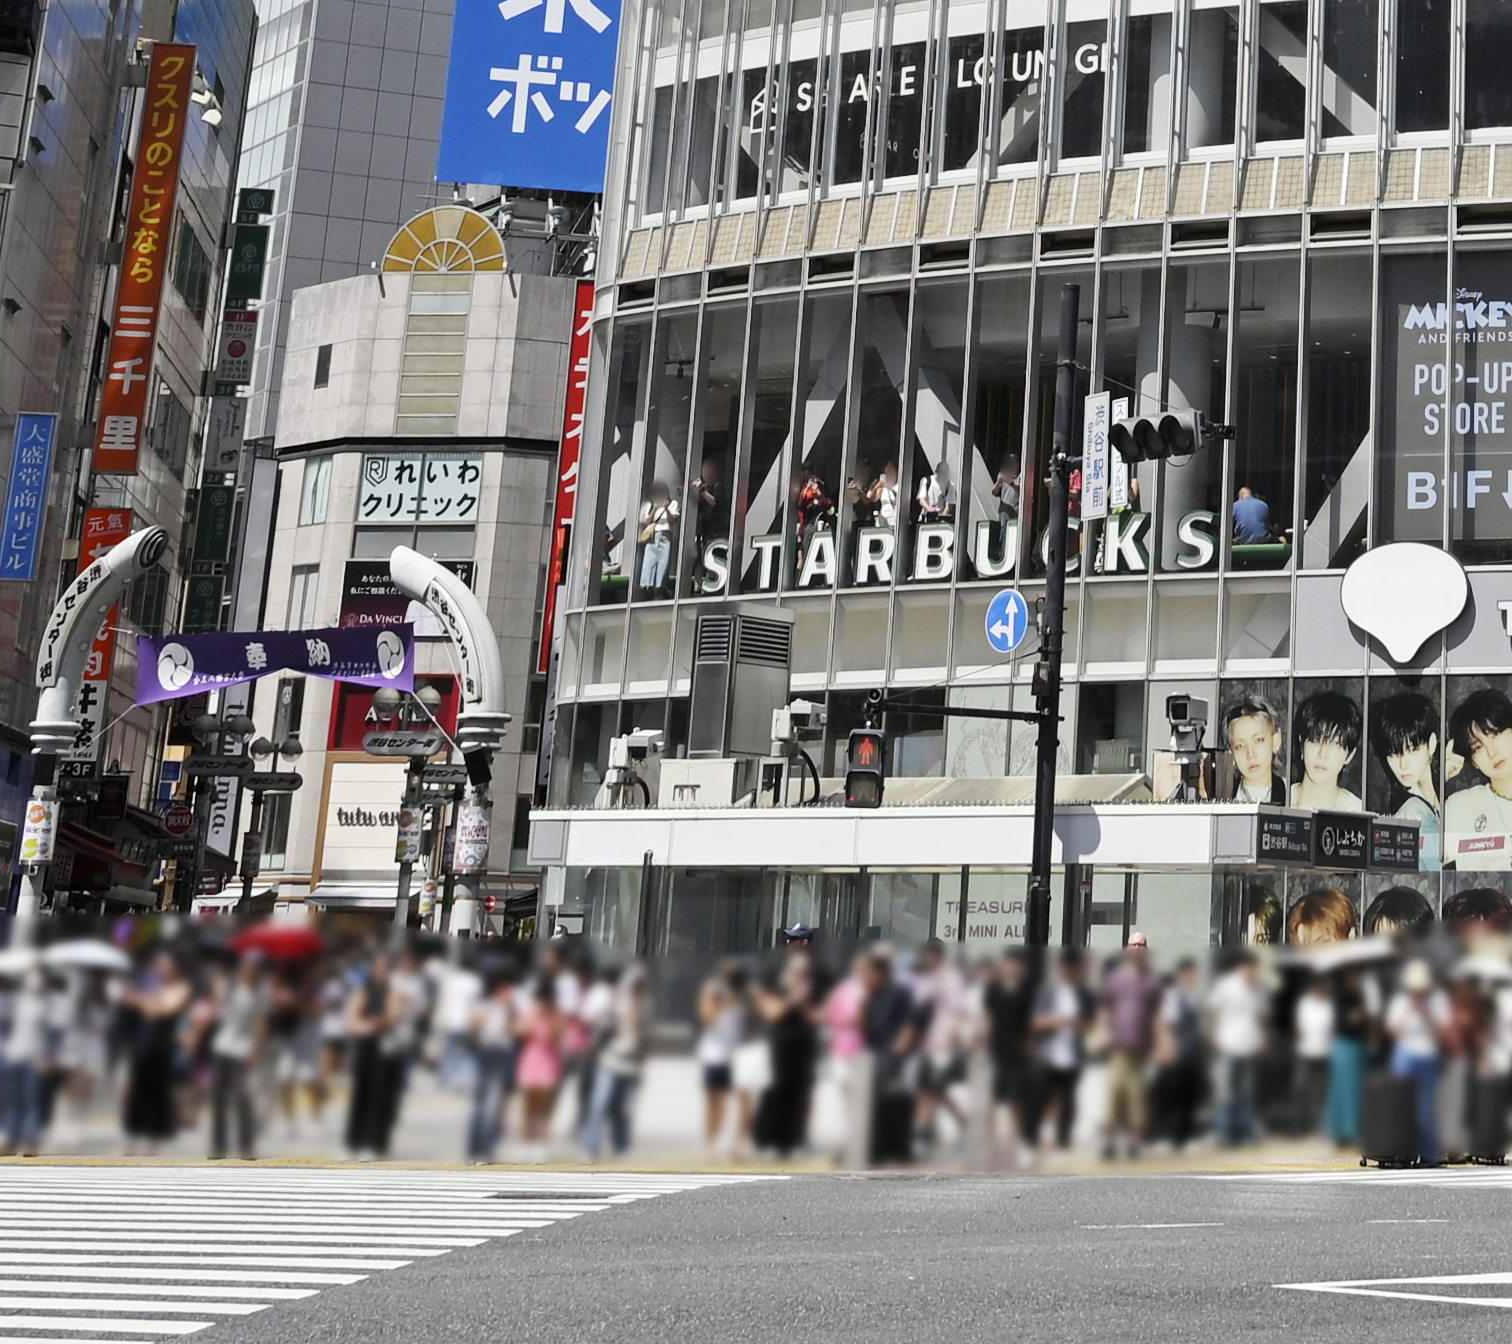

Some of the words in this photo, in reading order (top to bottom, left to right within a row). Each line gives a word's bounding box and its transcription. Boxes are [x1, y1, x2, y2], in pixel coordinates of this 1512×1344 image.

[128, 54, 186, 285] クスリのことなら
[98, 303, 155, 451] 三千里
[218, 385, 233, 395] 3F
[1423, 402, 1506, 436] STORE
[1092, 404, 1105, 509] 渋谷駅前
[206, 474, 221, 483] 2F
[394, 459, 480, 486] れいわ
[4, 422, 48, 572] 大盛堂商事ビル
[361, 492, 478, 520] クリニック
[89, 513, 125, 532] 元氣
[195, 563, 210, 573] 1F
[39, 564, 103, 683] 渋谷センター街
[375, 613, 403, 624] VINCI
[968, 924, 998, 939] MINI
